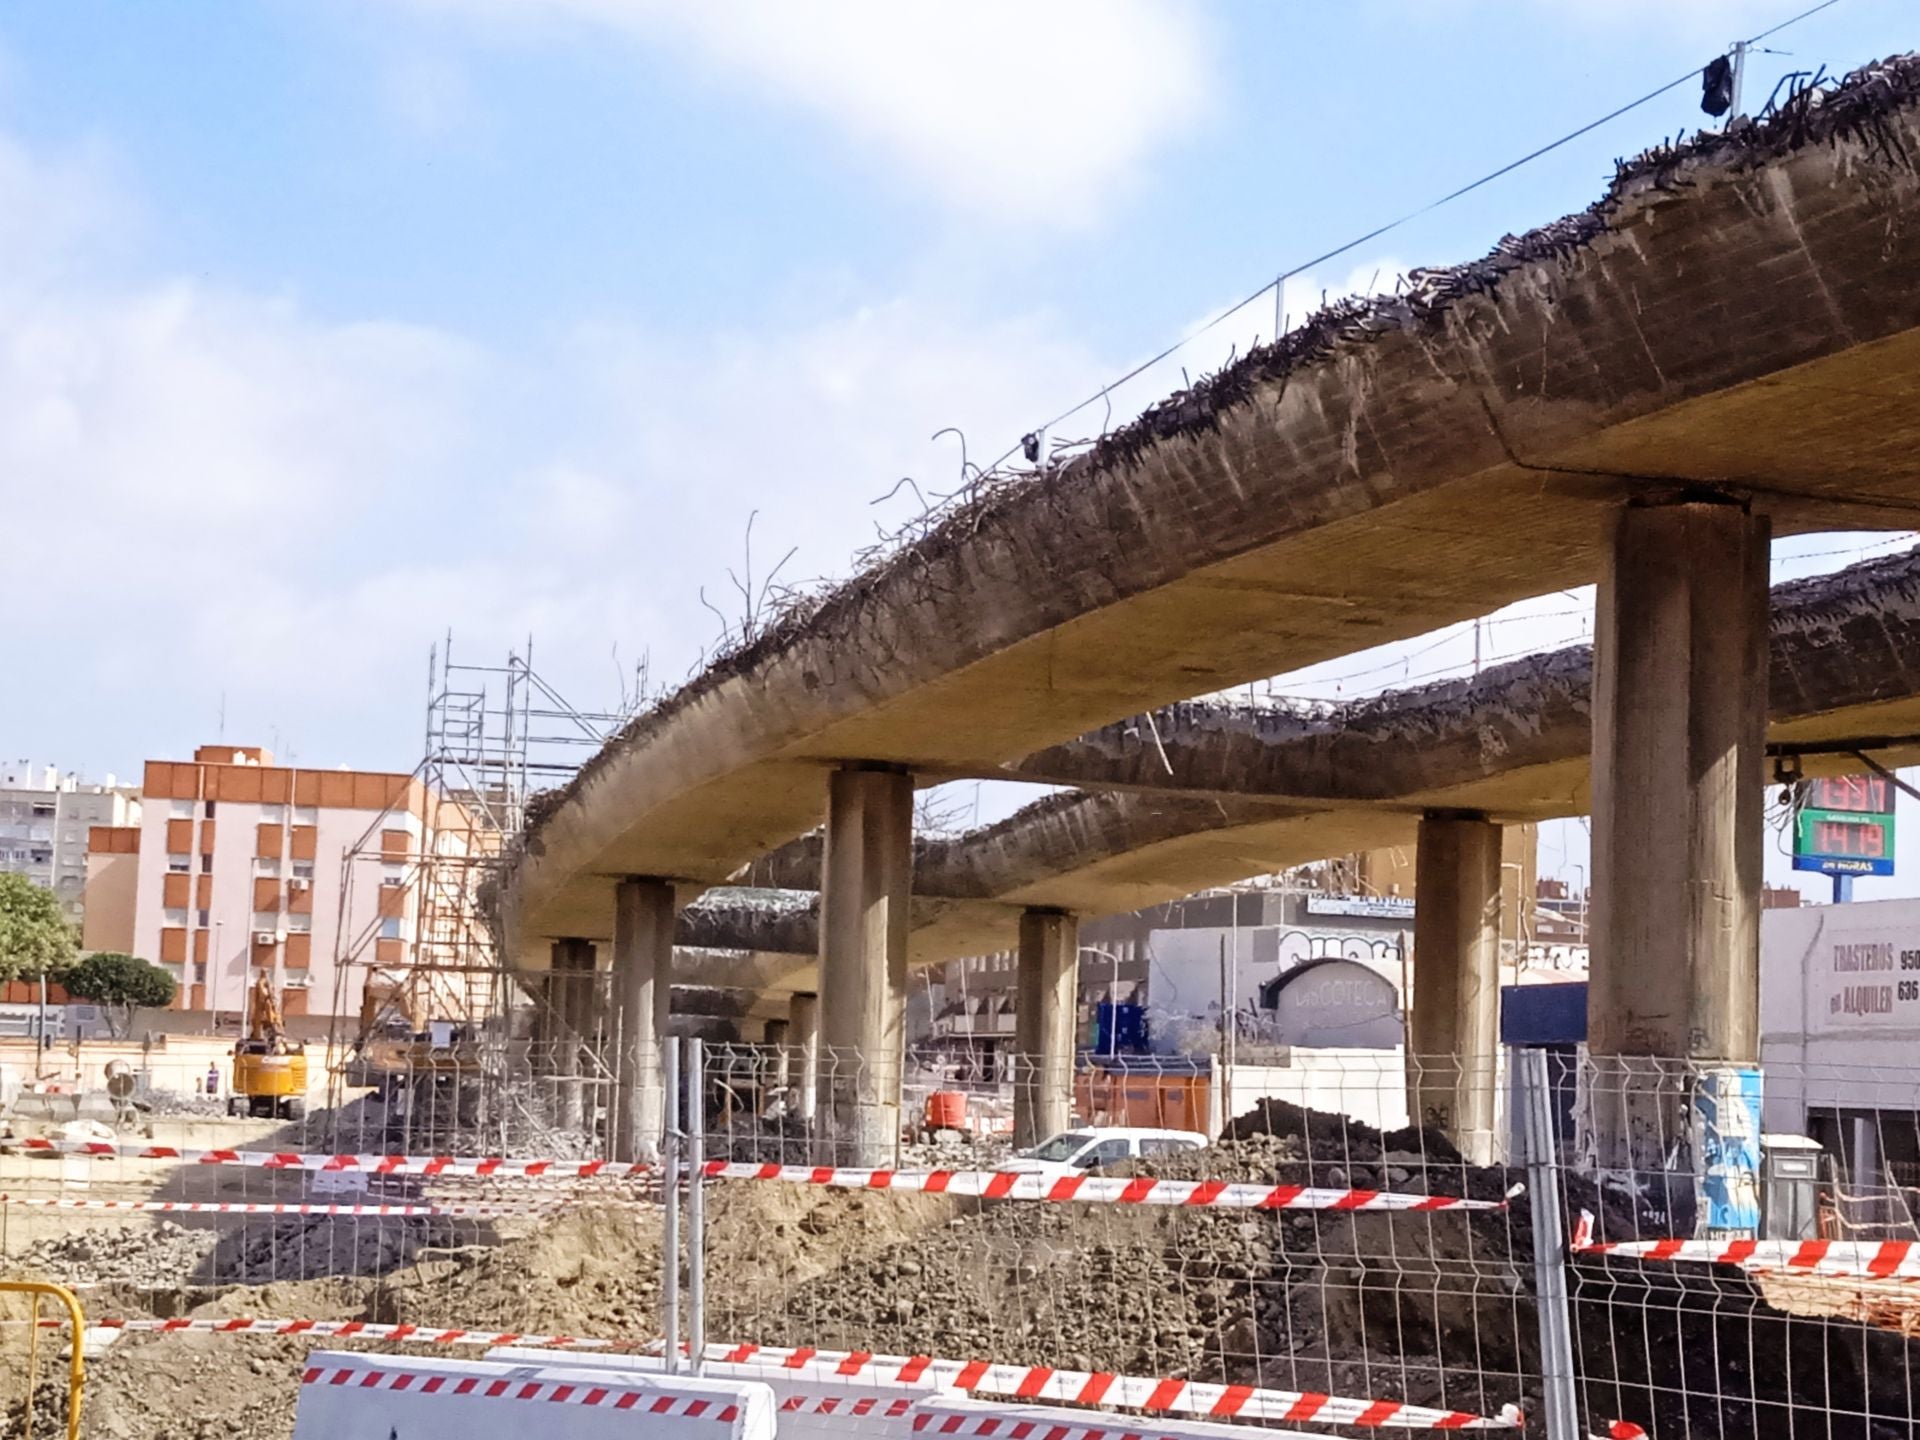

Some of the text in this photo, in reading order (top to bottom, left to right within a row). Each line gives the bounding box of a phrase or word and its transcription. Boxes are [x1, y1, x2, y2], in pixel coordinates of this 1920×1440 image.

[1833, 942, 1920, 972] TRASTEROS 950
[1843, 985, 1893, 1017] ALQUILER
[1897, 980, 1919, 1001] 636
